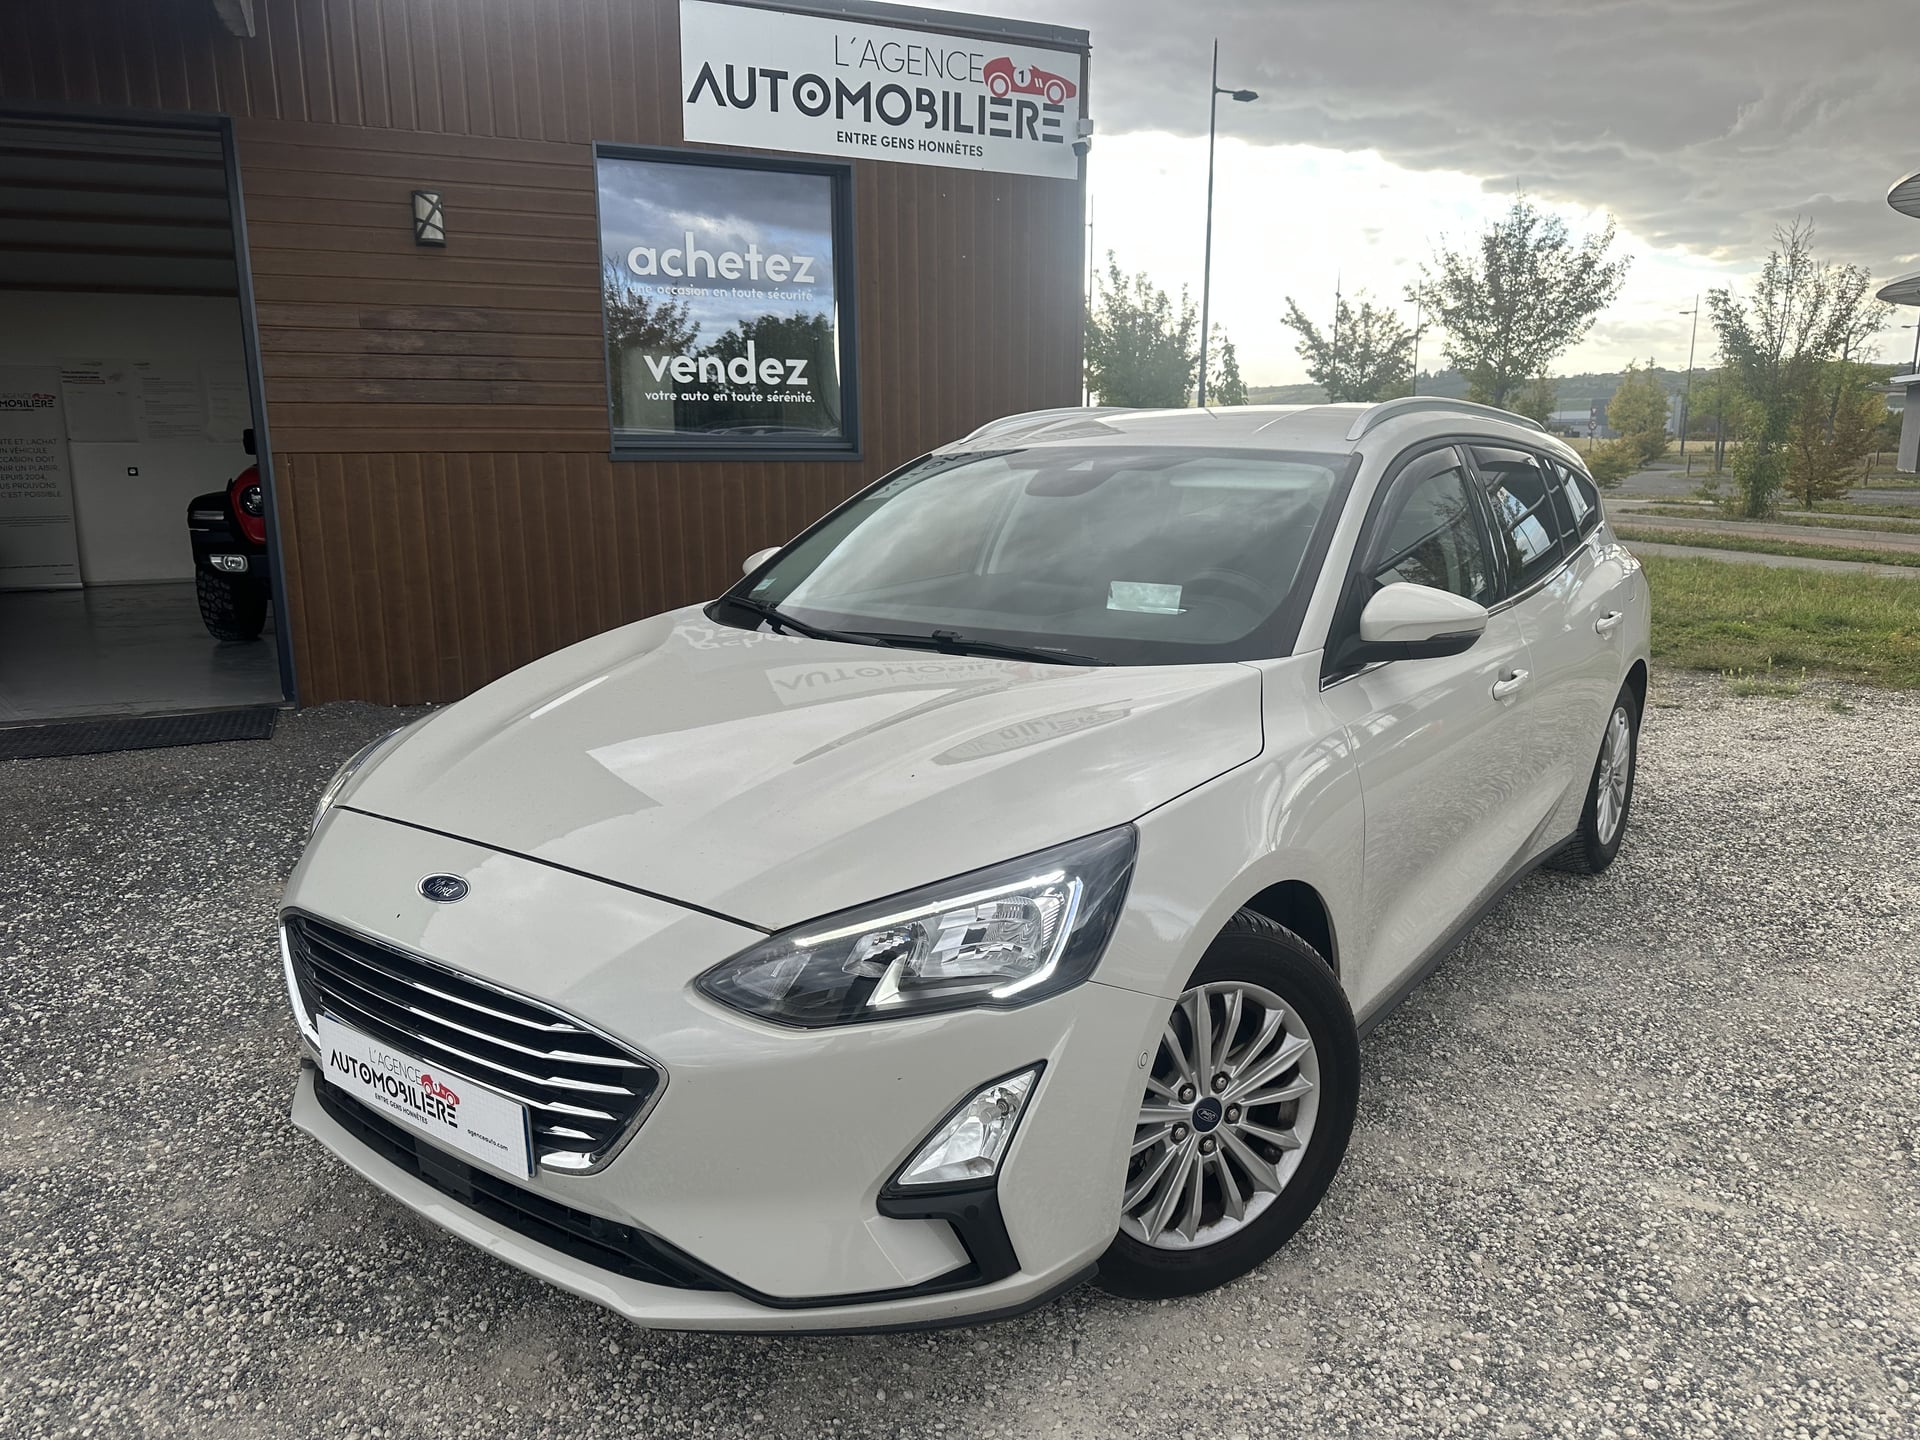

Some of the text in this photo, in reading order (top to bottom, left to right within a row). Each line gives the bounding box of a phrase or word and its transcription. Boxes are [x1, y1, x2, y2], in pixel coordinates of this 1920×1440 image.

[834, 34, 984, 83] L'AGENCE
[1018, 69, 1026, 85] 1
[837, 130, 984, 158] ENTRE GENS HONNÊTES
[627, 231, 815, 284] achetez
[630, 285, 652, 294] une
[657, 285, 709, 297] occasion
[713, 289, 728, 297] en
[732, 287, 764, 299] toute
[643, 340, 808, 385] vendez
[645, 390, 815, 403] votre auto en toute sérénité.
